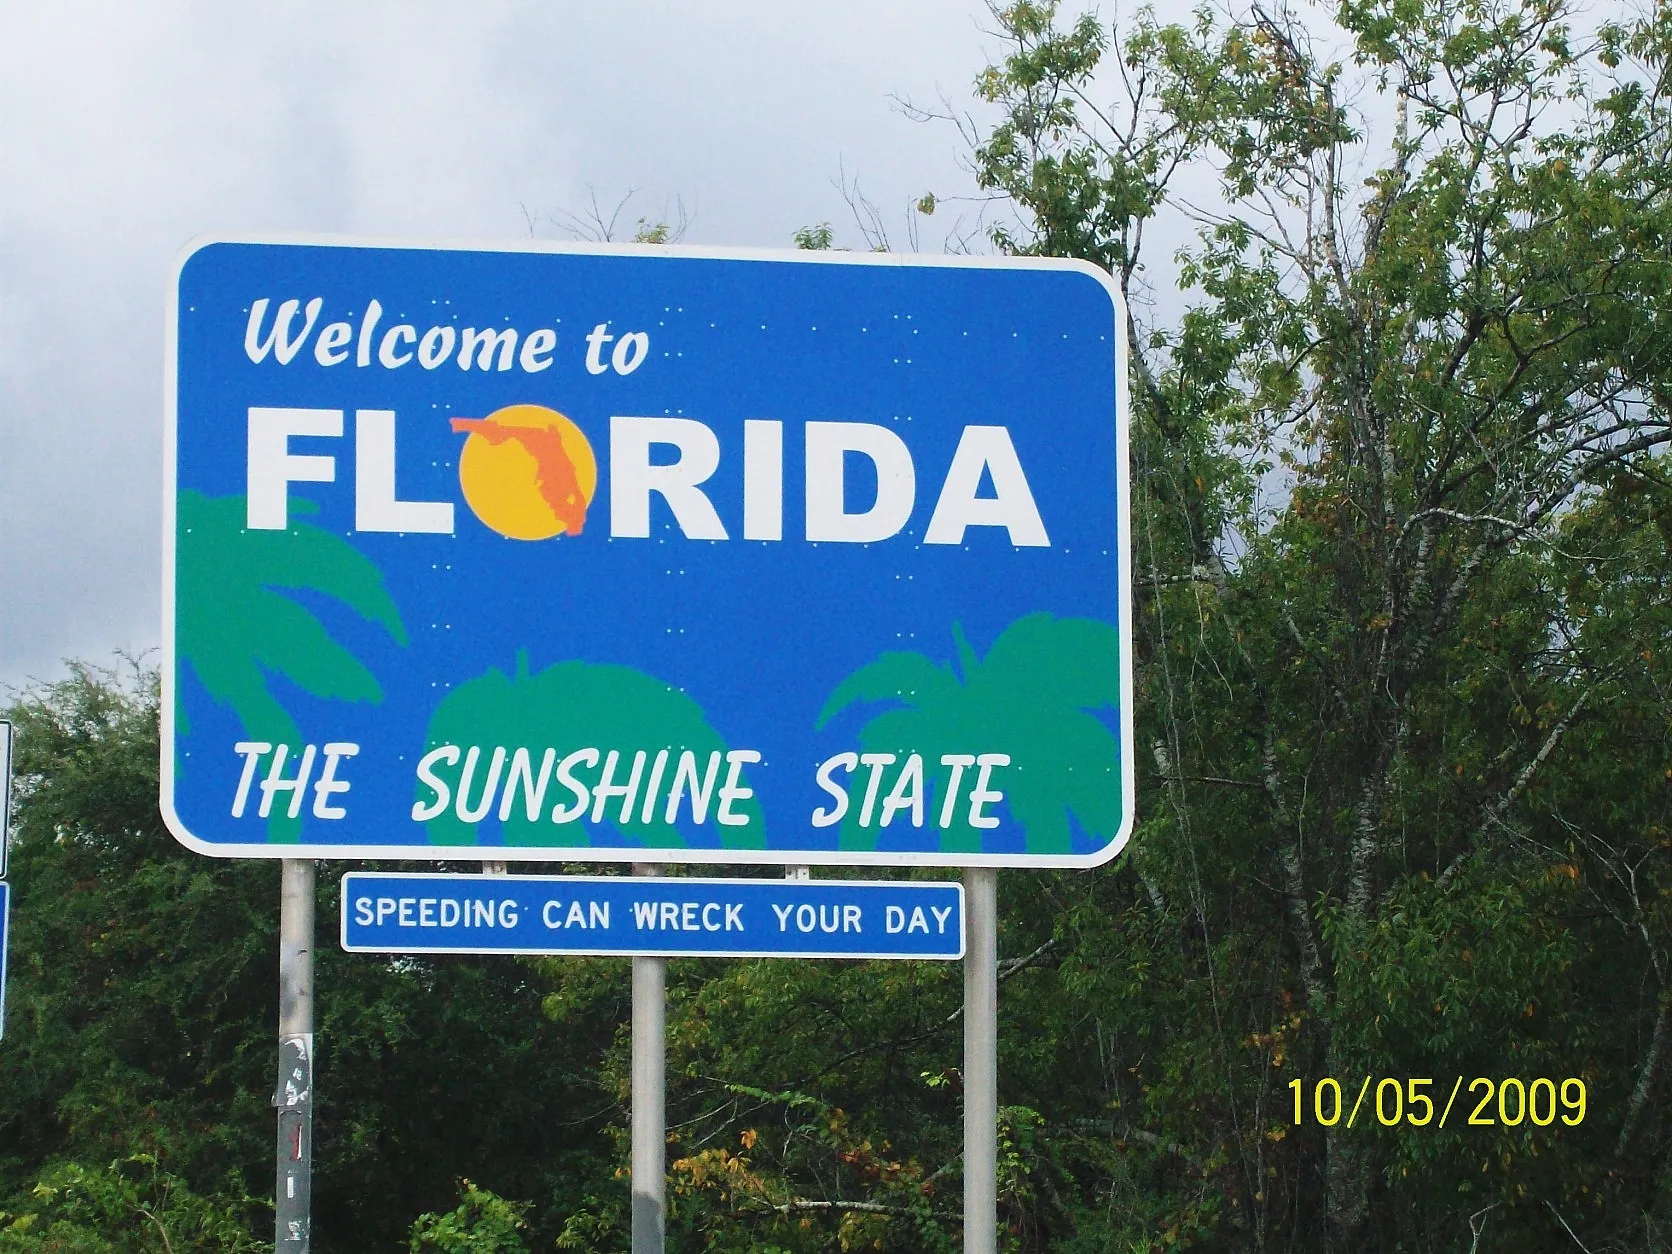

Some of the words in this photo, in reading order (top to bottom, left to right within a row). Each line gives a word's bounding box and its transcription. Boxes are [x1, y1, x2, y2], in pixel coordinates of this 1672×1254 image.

[244, 297, 557, 374] Welcome
[585, 323, 649, 376] to
[247, 404, 1051, 547] FLORIDA
[231, 741, 360, 820] THE
[411, 744, 761, 826] SUNSHINE
[812, 752, 1011, 829] STATE
[355, 897, 519, 929] SPEEDING
[542, 901, 609, 930] CAN
[633, 902, 745, 932] WRECK
[772, 904, 862, 934] YOUR
[885, 906, 953, 935] DAY
